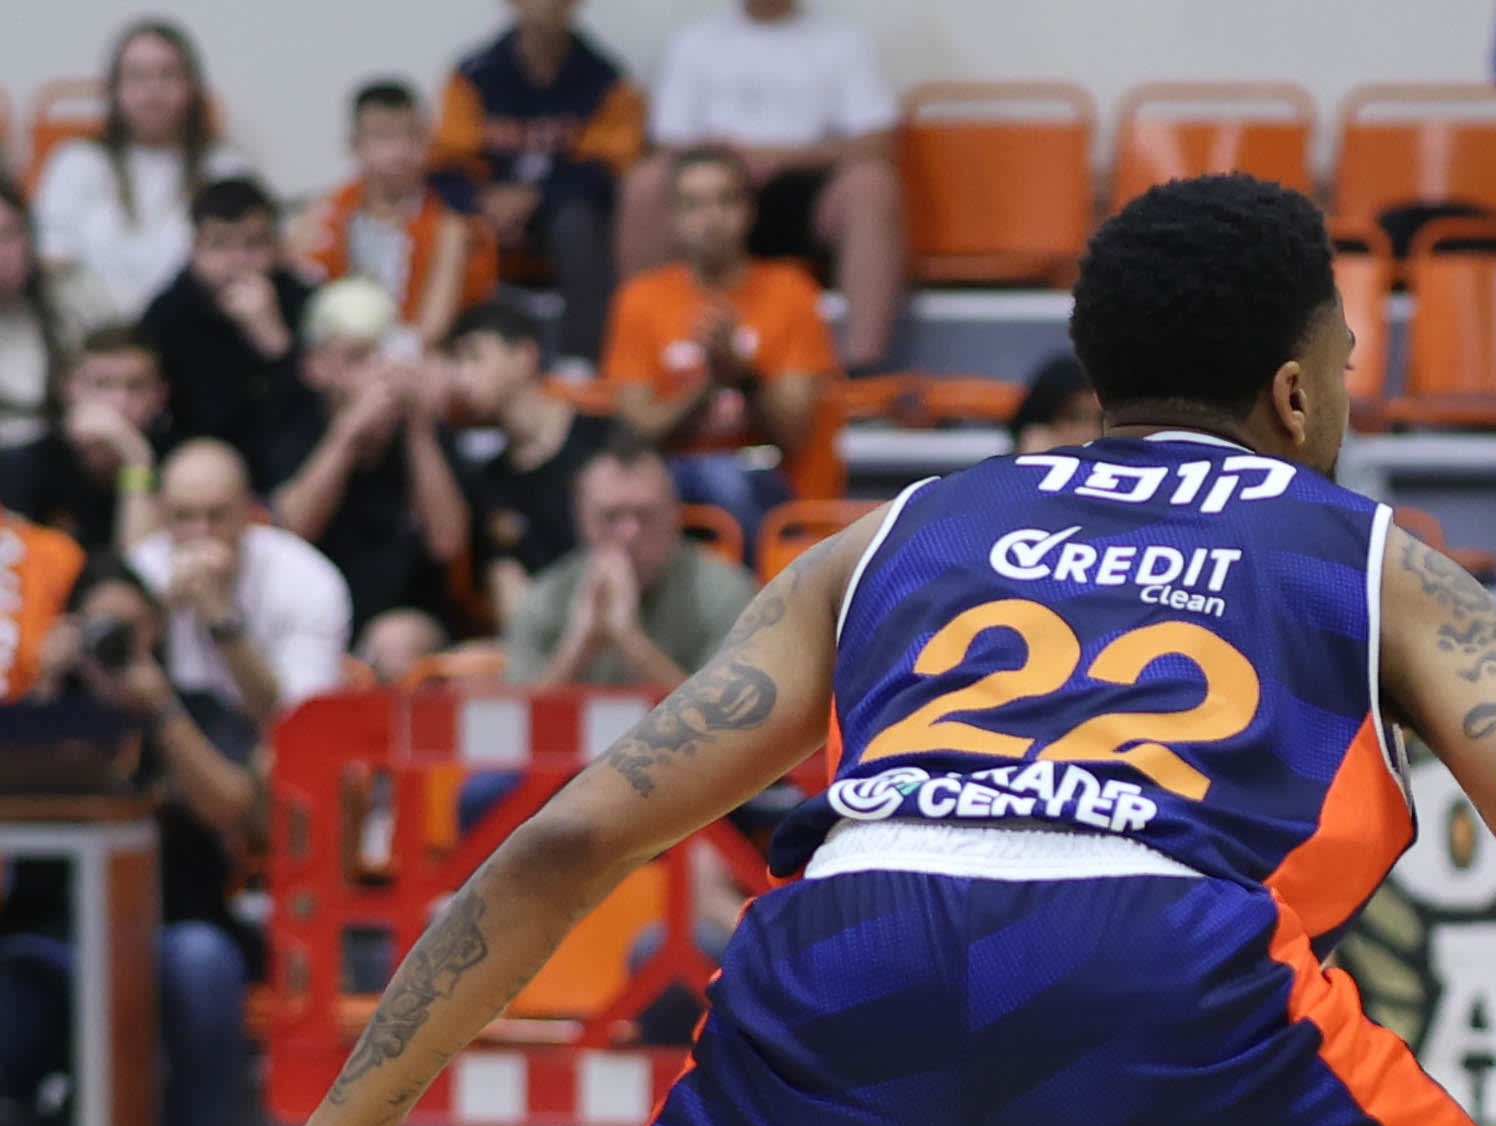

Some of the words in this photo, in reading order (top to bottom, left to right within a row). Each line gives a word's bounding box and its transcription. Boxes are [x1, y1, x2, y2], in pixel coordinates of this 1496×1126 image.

[1014, 455, 1297, 513] קופר
[989, 525, 1243, 593] CREDIT
[1139, 584, 1226, 618] Clean
[860, 599, 1261, 801] 22
